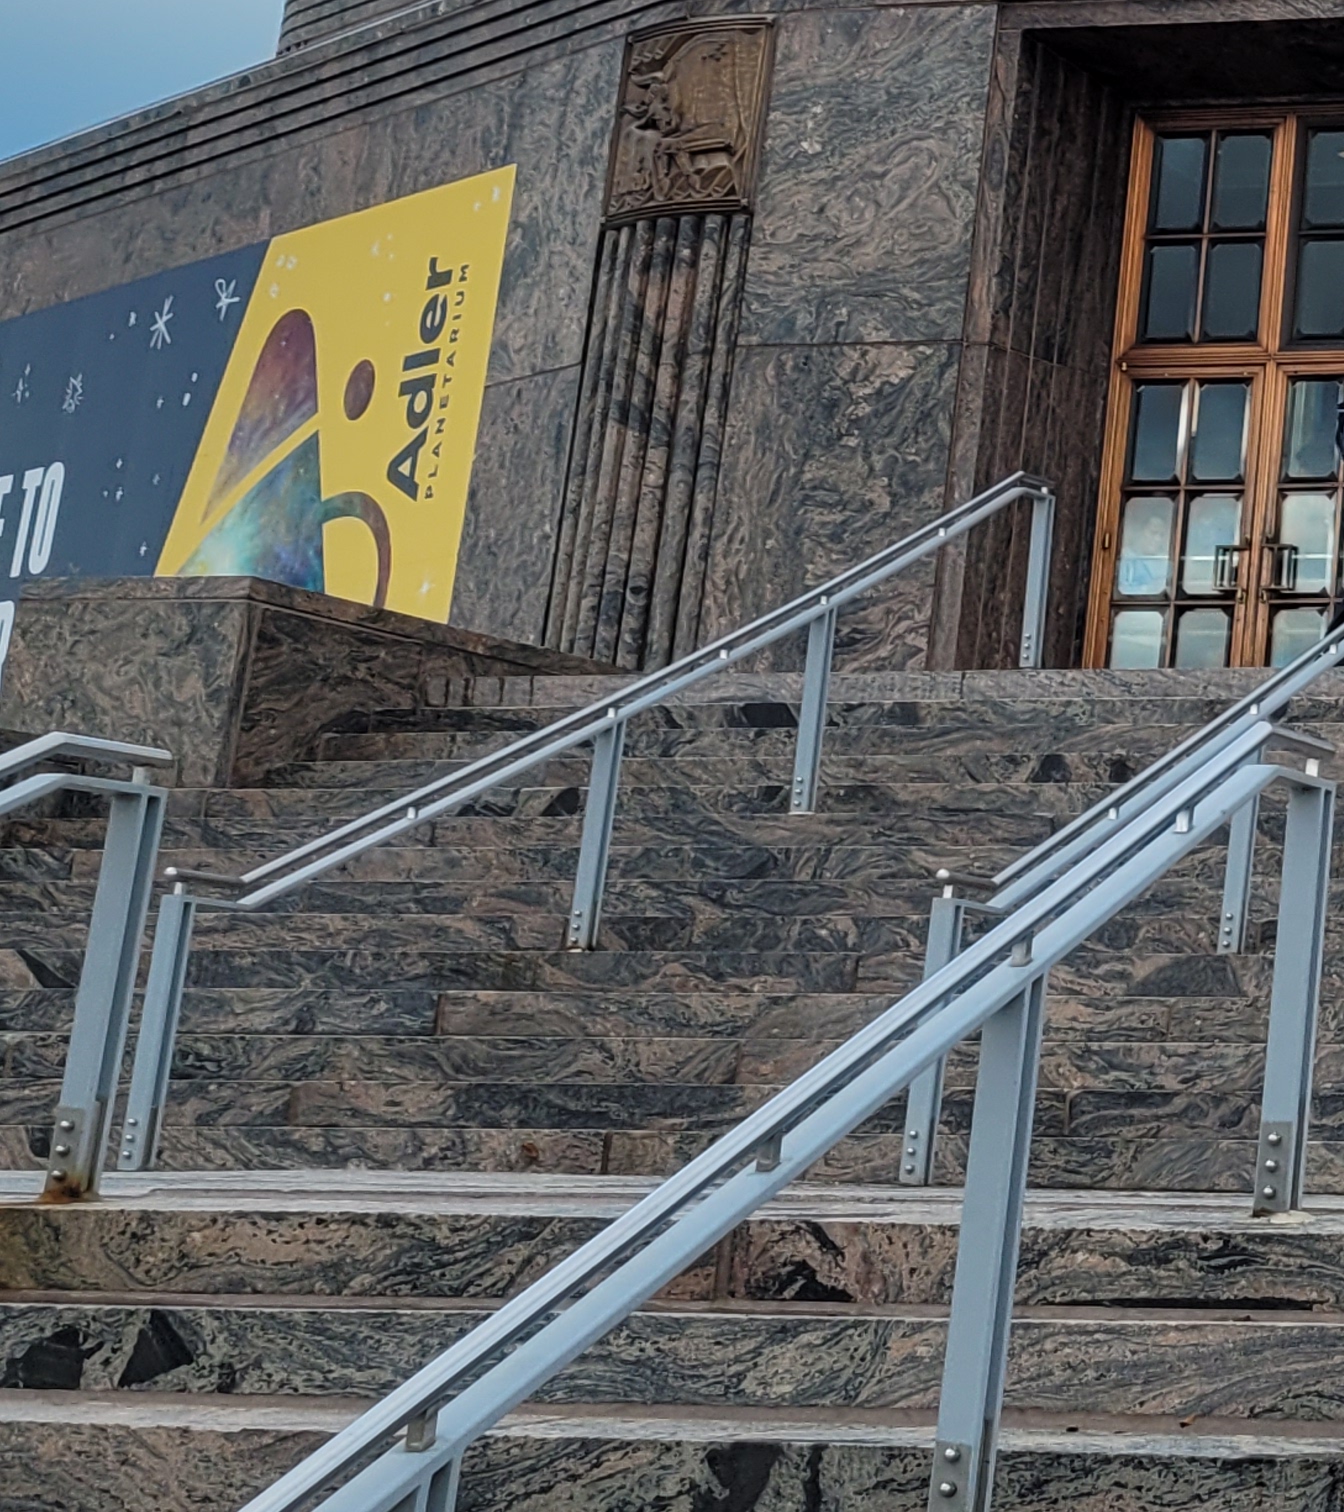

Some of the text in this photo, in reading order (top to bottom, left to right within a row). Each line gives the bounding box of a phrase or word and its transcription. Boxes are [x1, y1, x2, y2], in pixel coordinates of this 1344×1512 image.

[387, 257, 453, 502] Adler
[424, 264, 470, 499] PLANETARIUM
[9, 461, 65, 578] TO
